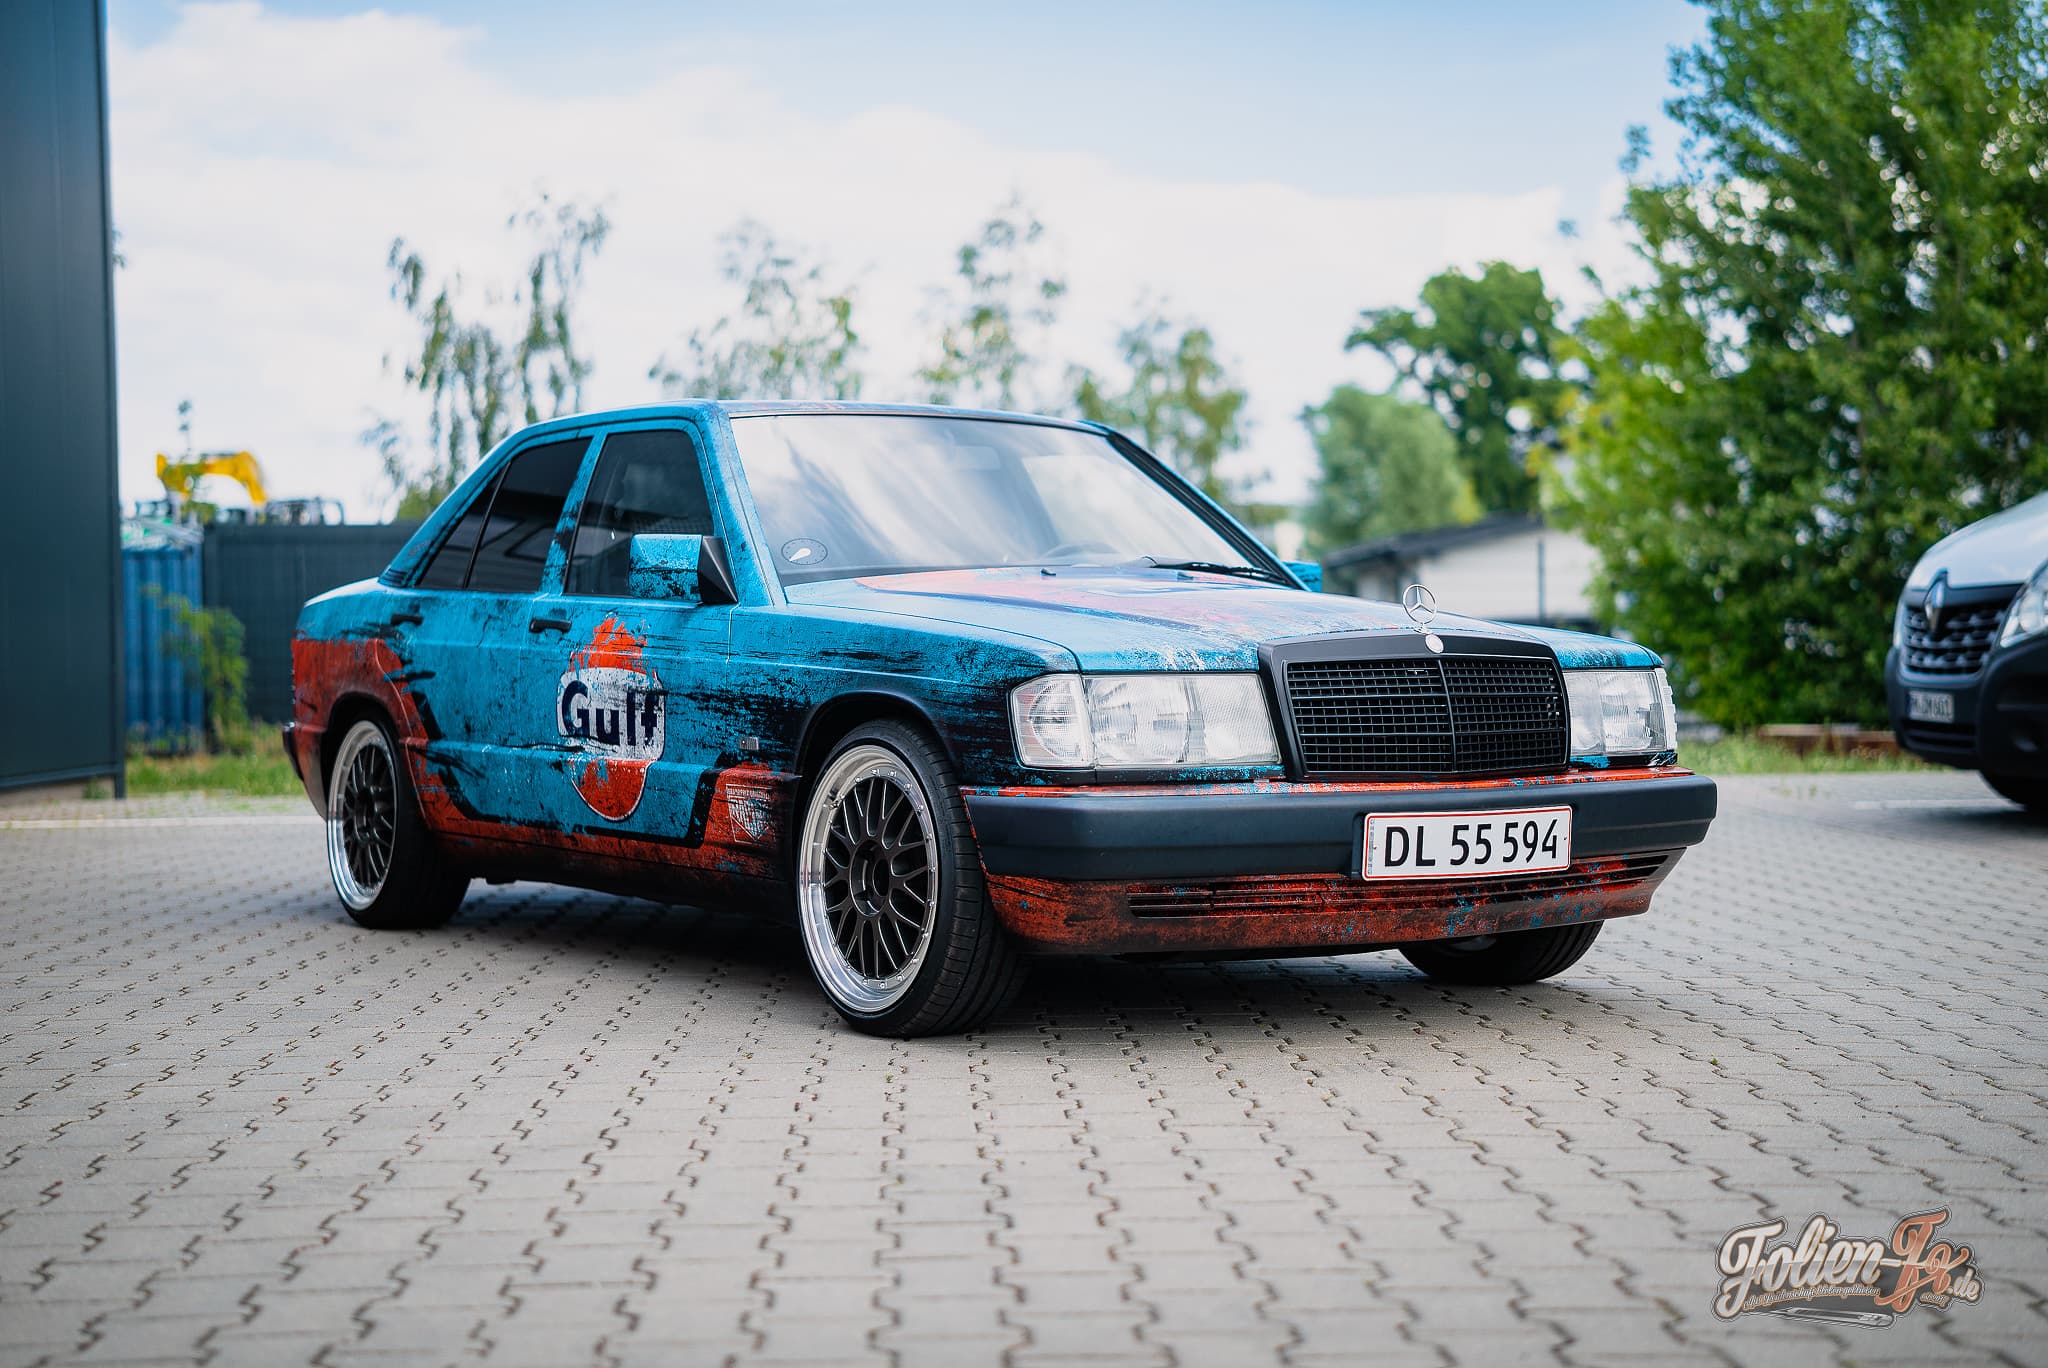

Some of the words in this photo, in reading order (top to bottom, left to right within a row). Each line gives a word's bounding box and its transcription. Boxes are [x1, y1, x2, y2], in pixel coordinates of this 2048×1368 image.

[561, 679, 659, 747] Gulf
[1384, 825, 1436, 868] DL
[1449, 823, 1493, 867] 55
[1502, 818, 1559, 864] 594
